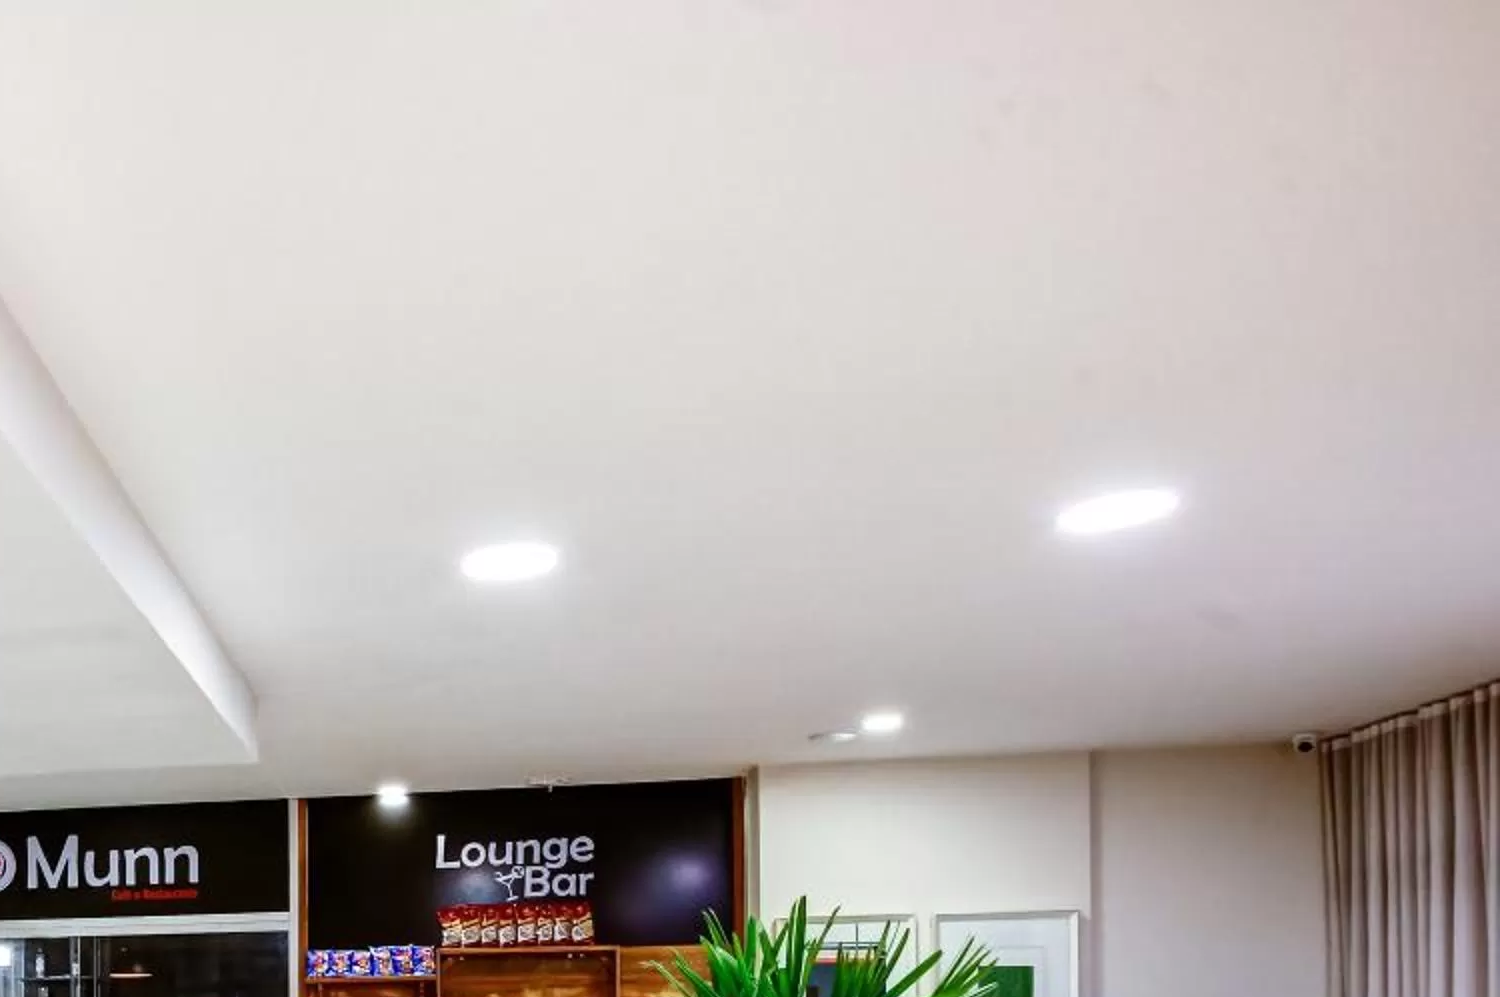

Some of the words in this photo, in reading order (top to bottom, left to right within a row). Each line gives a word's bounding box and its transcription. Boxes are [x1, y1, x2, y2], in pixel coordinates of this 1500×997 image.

[26, 833, 200, 889] Munn
[435, 833, 595, 870] Lounge
[523, 865, 595, 898] Bar
